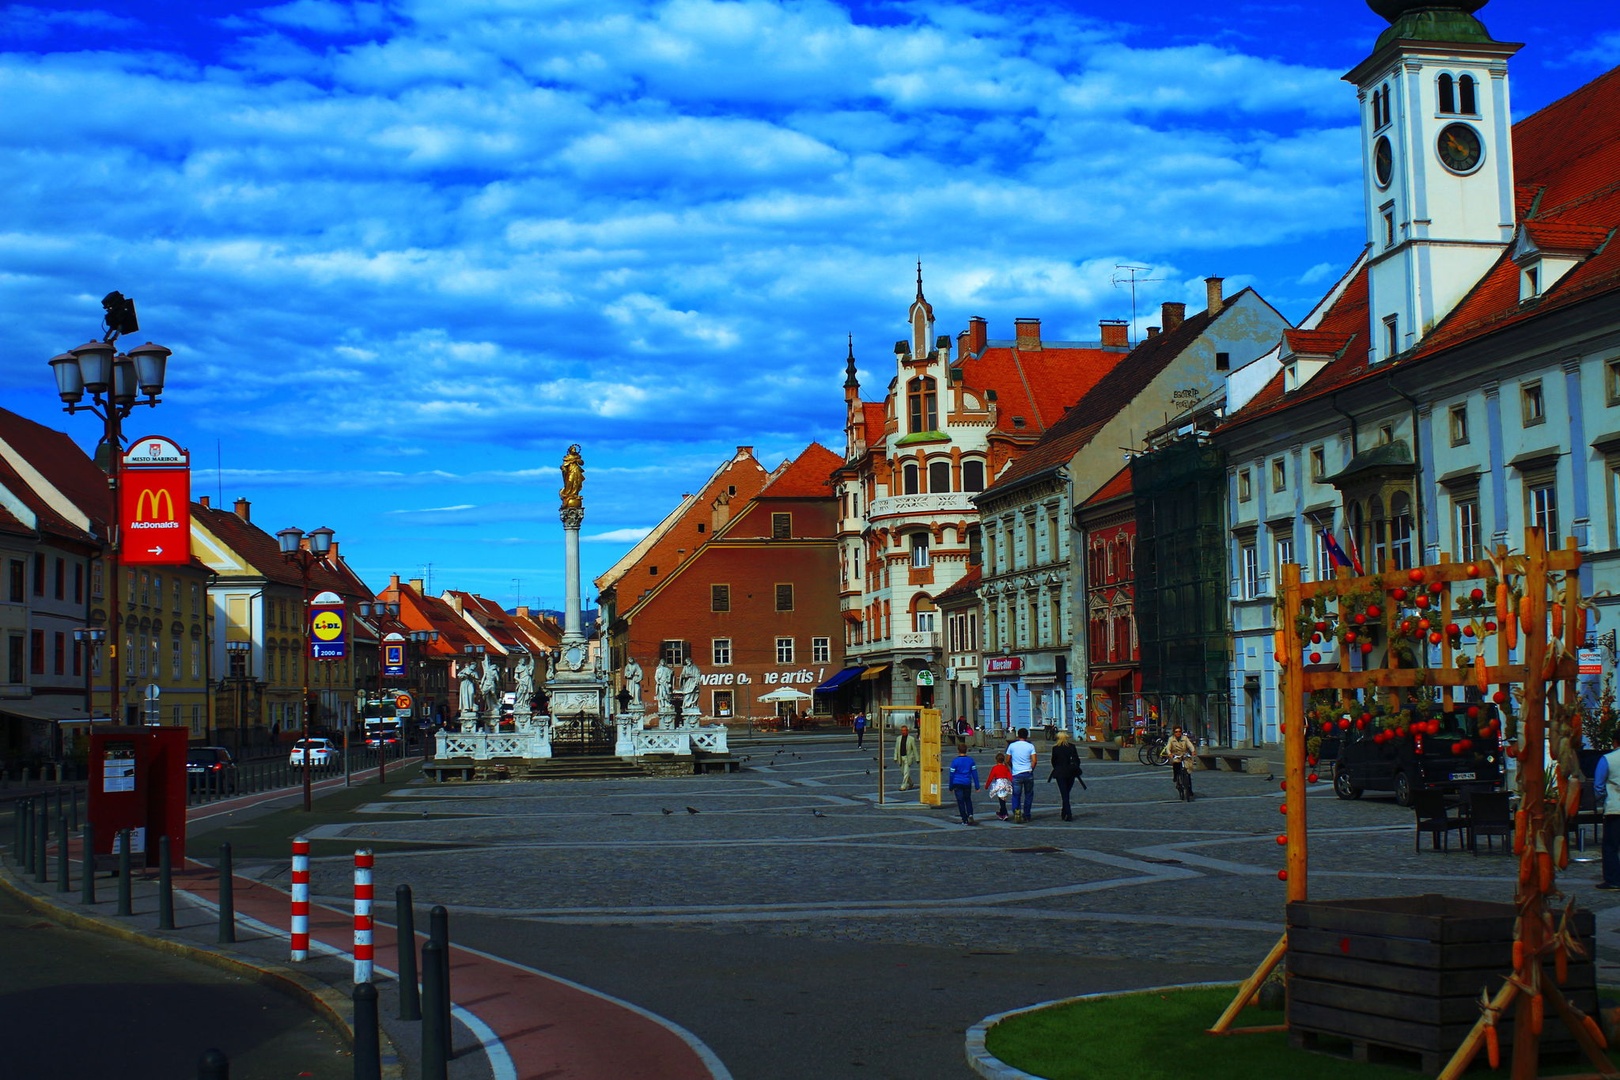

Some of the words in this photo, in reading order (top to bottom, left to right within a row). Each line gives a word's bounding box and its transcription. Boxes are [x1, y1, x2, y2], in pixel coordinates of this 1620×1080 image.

[131, 521, 179, 529] McDonald's
[699, 672, 734, 686] ware
[780, 669, 814, 684] artis
